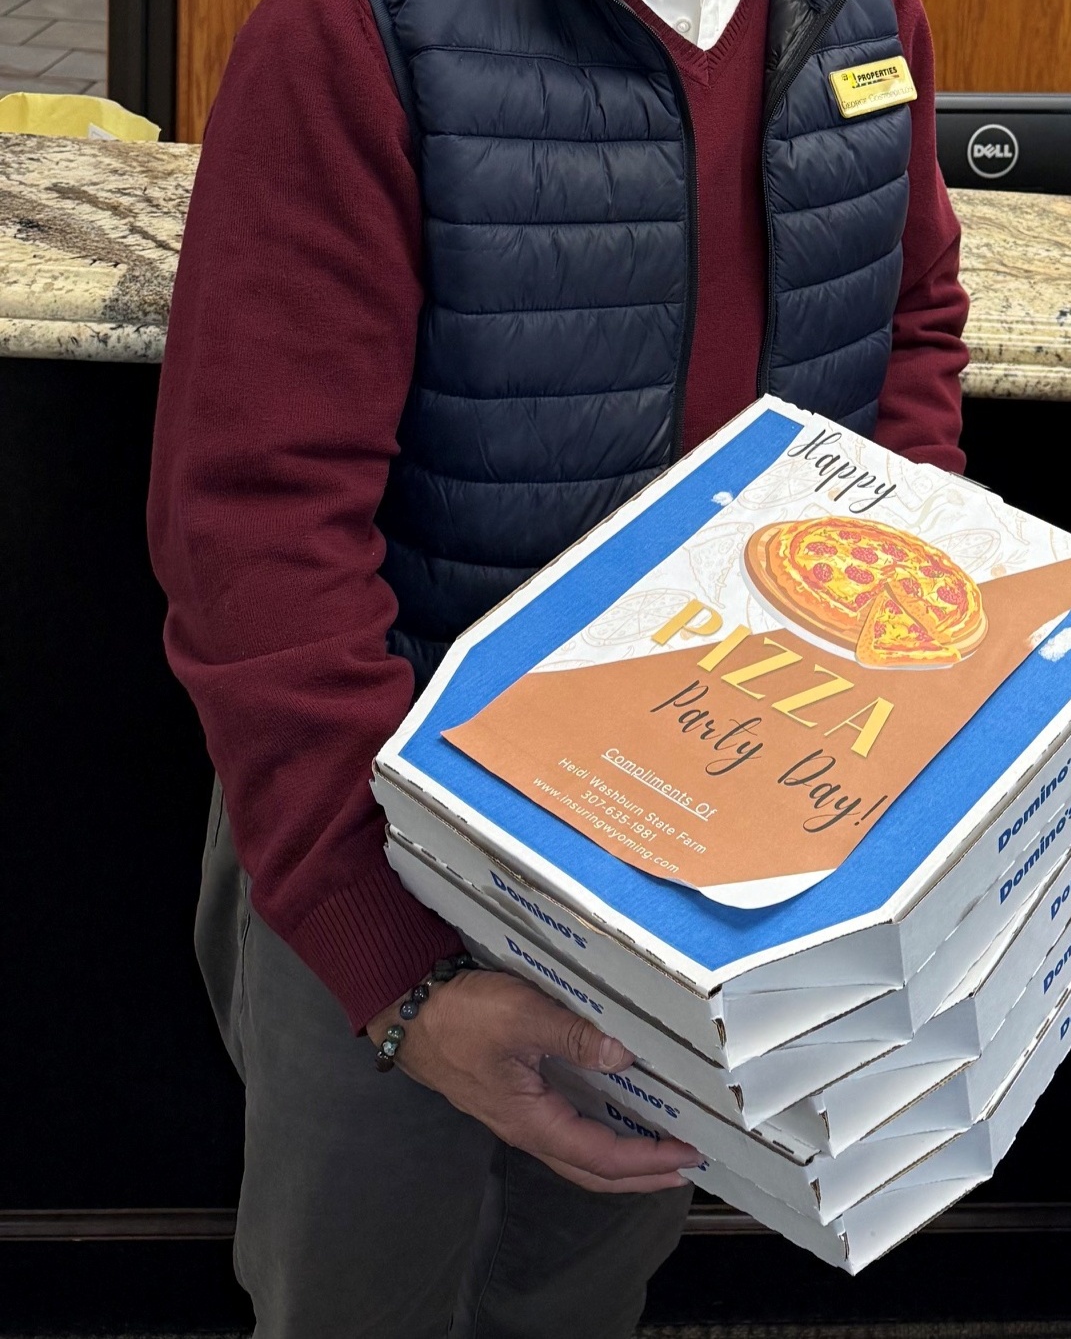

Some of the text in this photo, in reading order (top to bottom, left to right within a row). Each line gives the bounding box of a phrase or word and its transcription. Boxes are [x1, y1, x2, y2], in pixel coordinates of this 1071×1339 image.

[857, 66, 898, 82] PROPERTIES
[973, 143, 1013, 159] DELL
[787, 429, 897, 513] Happy
[651, 598, 895, 758] PIZZA
[602, 747, 717, 820] Compliments Of
[650, 680, 888, 833] Party Day!
[533, 777, 680, 874] www.insuringwyoming.com
[558, 757, 707, 854] Heidi Washburn State Farm
[581, 789, 657, 842] 307-635-1981
[490, 870, 587, 949] Domino's
[504, 935, 604, 1014] Domino's
[602, 1072, 680, 1119] mino's
